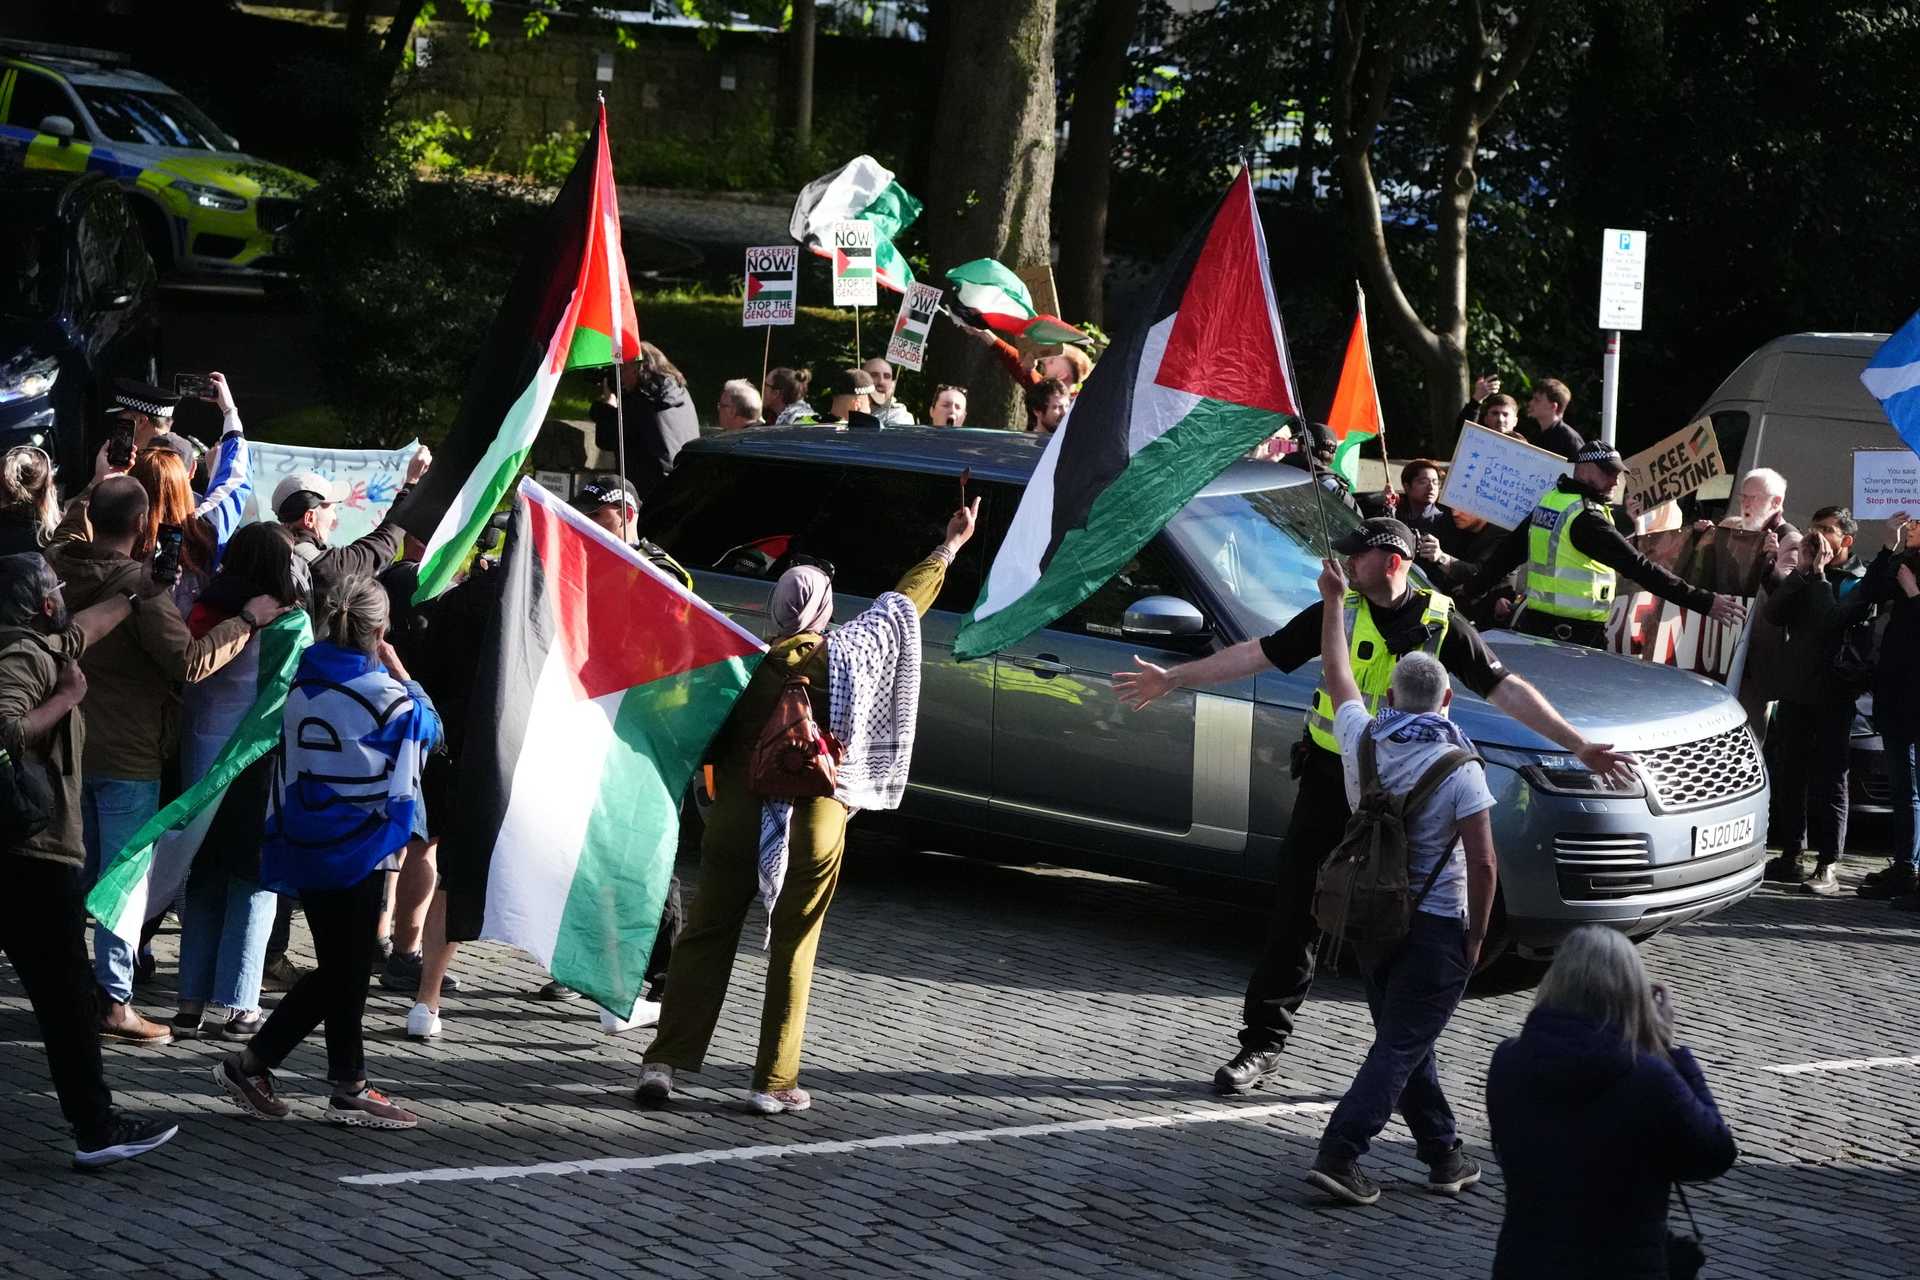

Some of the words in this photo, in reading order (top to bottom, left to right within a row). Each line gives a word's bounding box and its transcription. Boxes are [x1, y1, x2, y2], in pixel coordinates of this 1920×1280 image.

[747, 248, 796, 257] CEASEFIRE
[748, 255, 795, 272] NOW!
[747, 301, 771, 310] STOP
[775, 301, 792, 309] THE
[909, 293, 937, 315] OW!
[744, 309, 793, 319] GENOCIDE
[910, 341, 921, 353] THE
[1649, 442, 1690, 482] FREE
[1631, 452, 1718, 514] PALESTINE
[1892, 477, 1918, 486] through
[1866, 497, 1885, 505] Stop
[1886, 497, 1899, 505] the
[1701, 824, 1731, 850] SJ20
